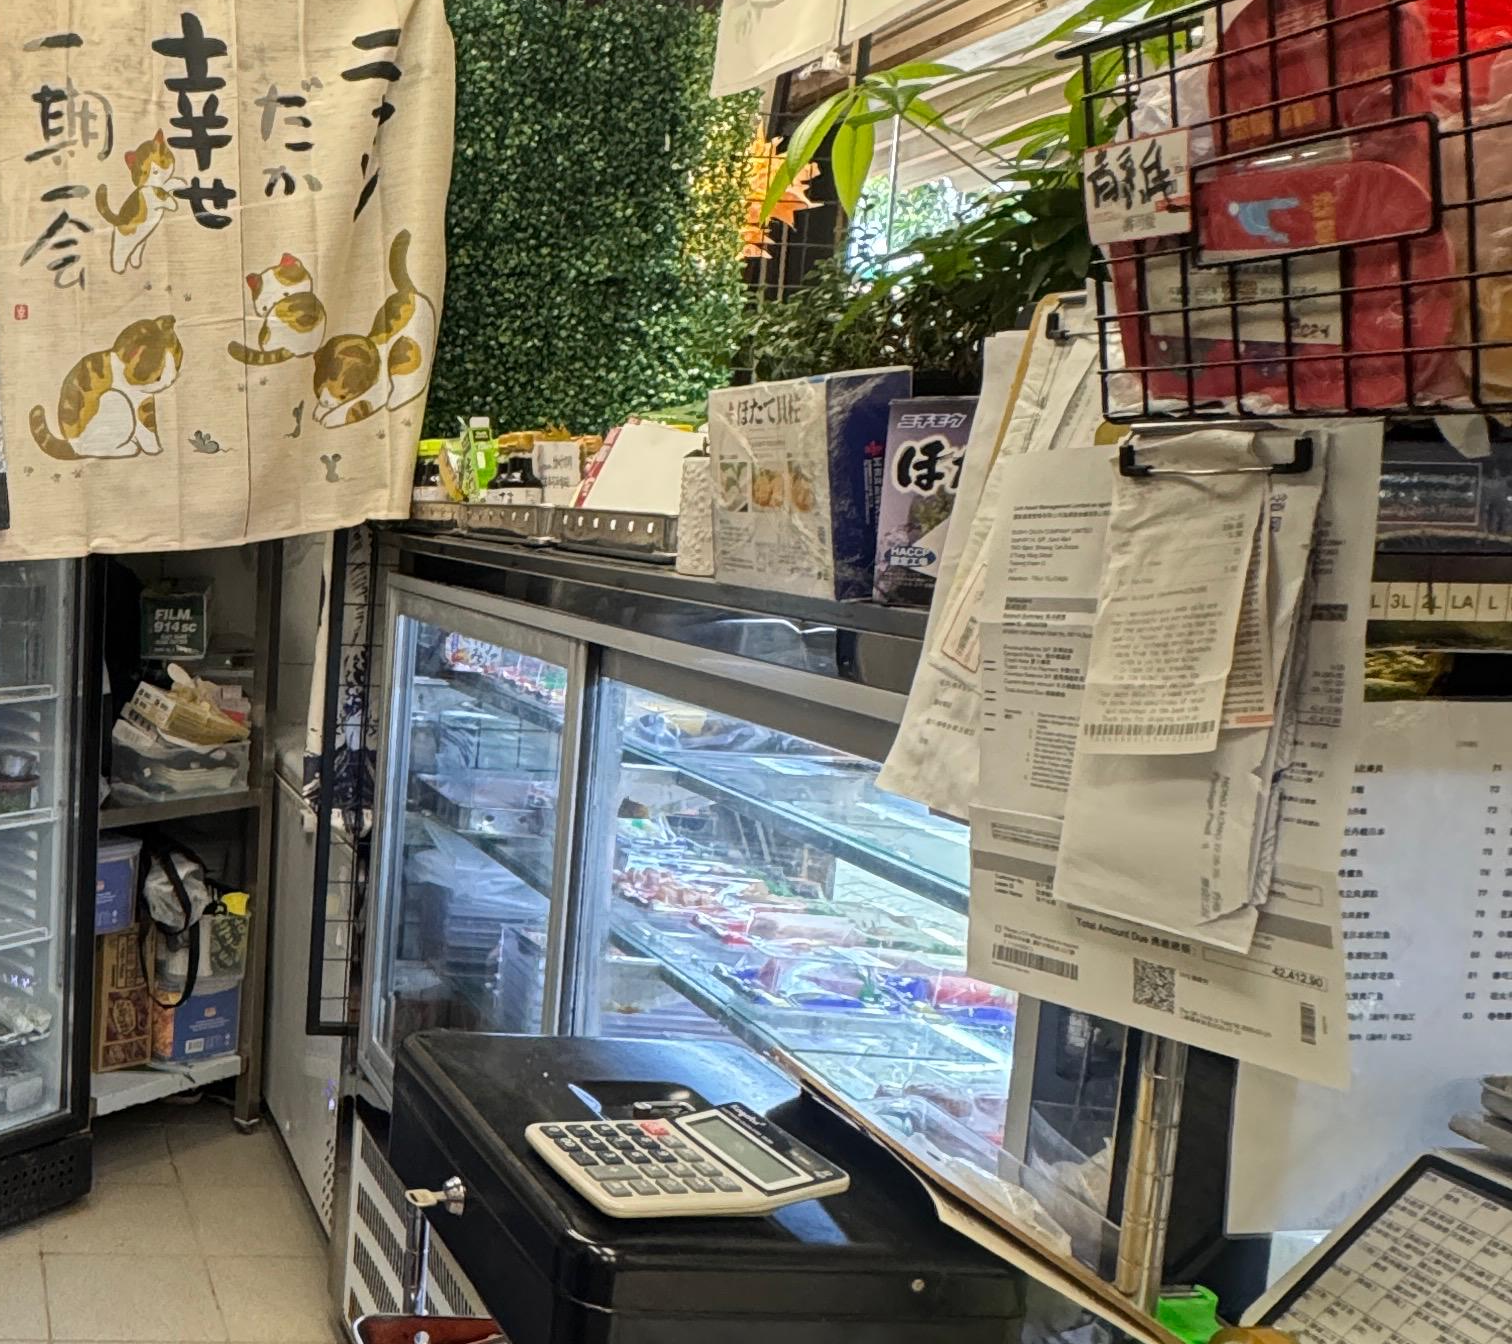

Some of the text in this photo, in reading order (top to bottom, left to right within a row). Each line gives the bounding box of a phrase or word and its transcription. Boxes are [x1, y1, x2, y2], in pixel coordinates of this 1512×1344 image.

[151, 11, 236, 230] 幸せ
[20, 33, 115, 290] 一期一会
[891, 546, 930, 557] HACCP
[1392, 594, 1410, 609] 3L
[1452, 595, 1473, 609] LA
[1489, 595, 1497, 609] L
[154, 608, 191, 621] FILM
[1075, 917, 1149, 944] Total Amount Due
